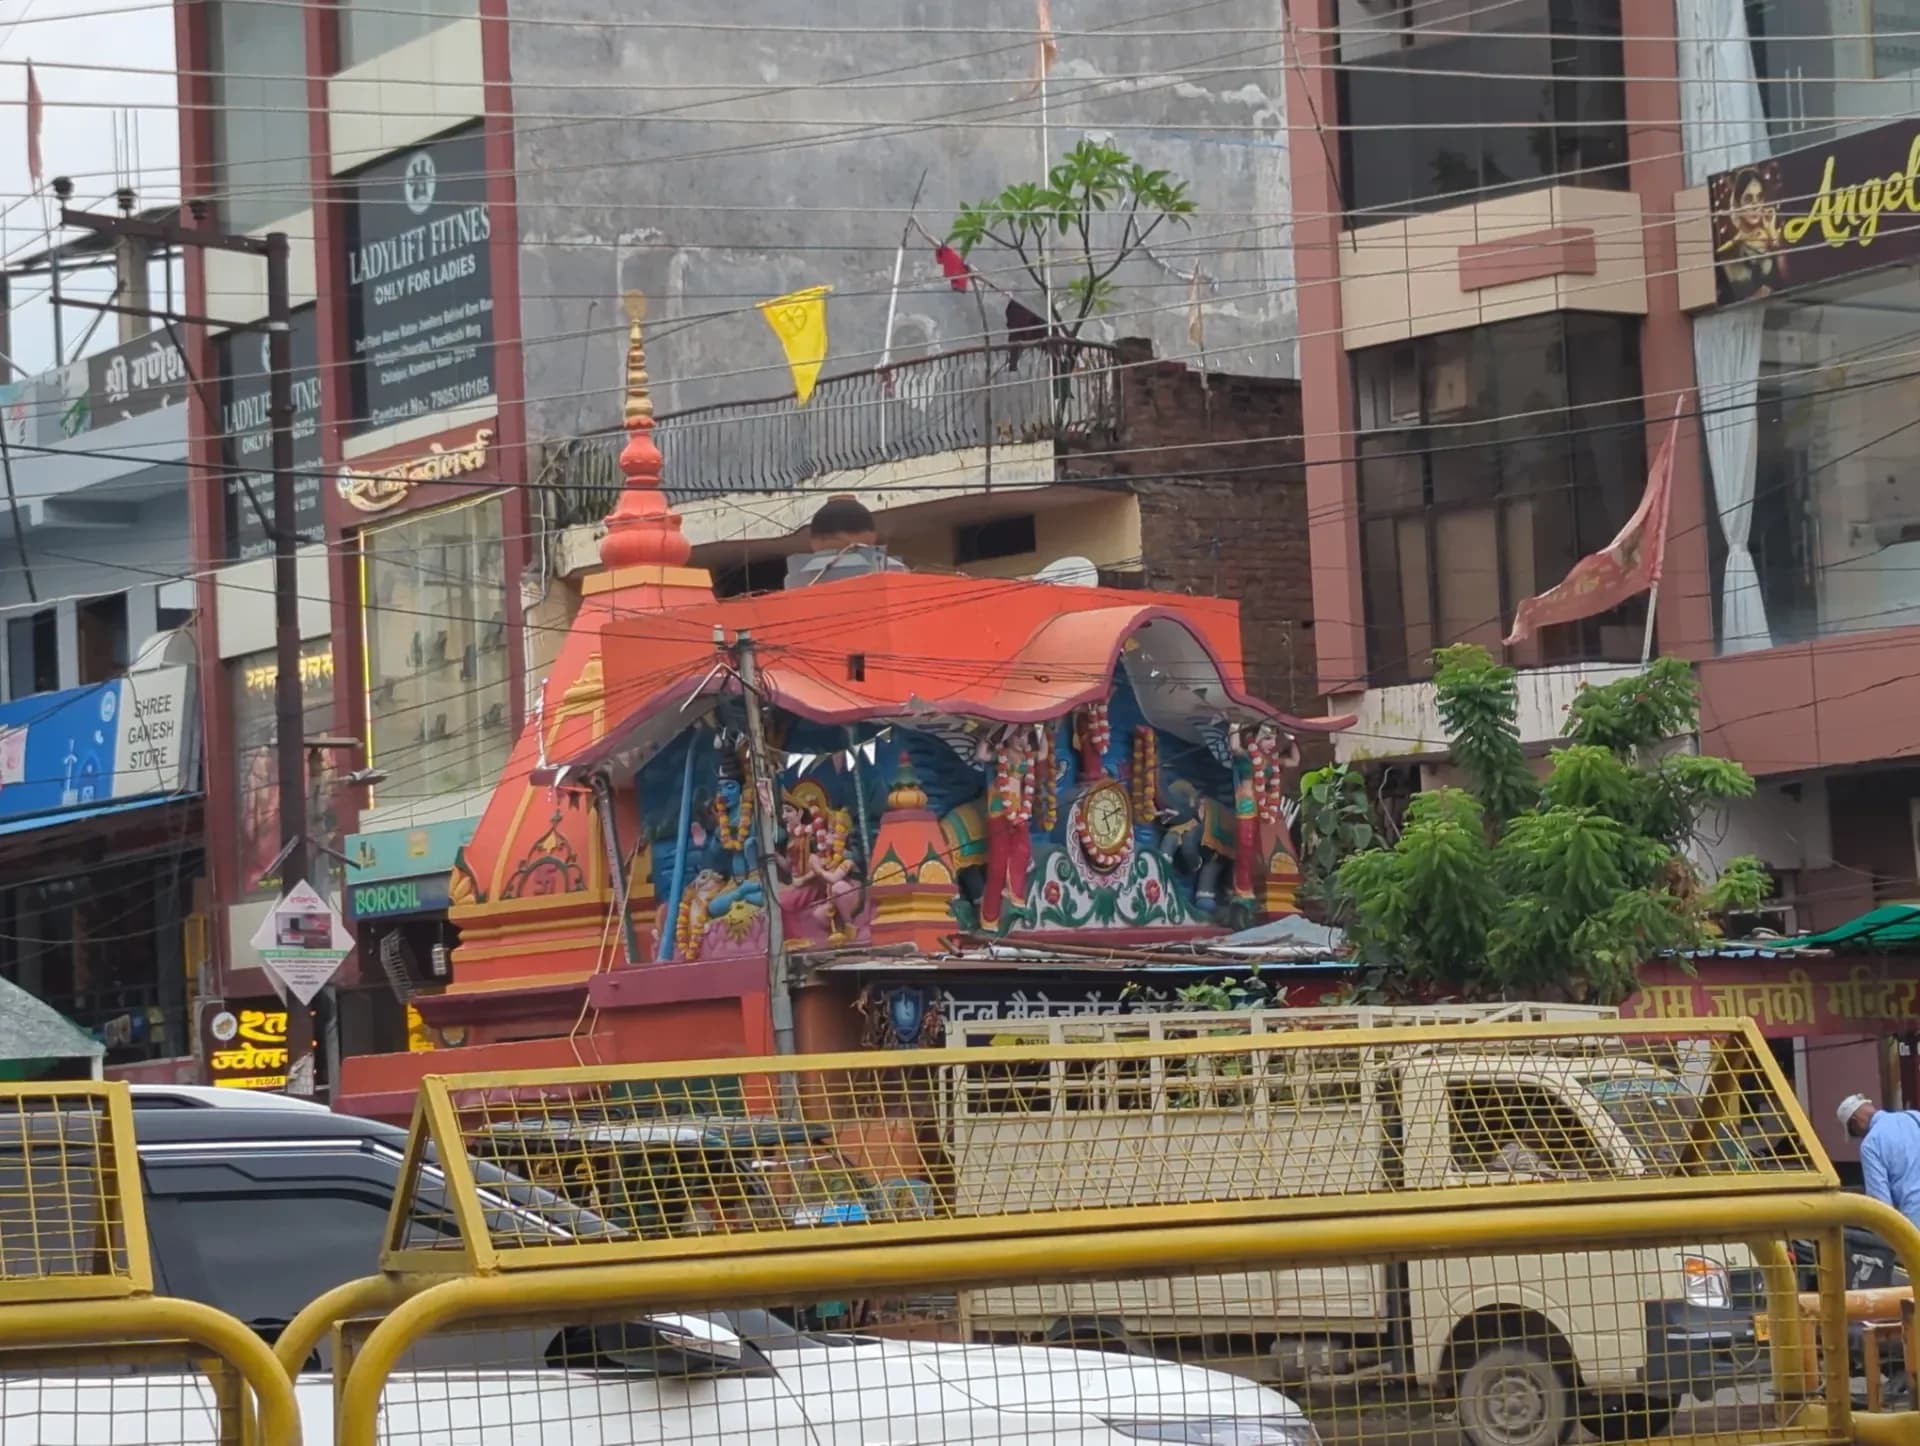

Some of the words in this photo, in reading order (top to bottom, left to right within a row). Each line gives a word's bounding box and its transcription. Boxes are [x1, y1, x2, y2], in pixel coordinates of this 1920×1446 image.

[1784, 133, 1920, 248] Angel
[350, 225, 426, 285] LADYLIFT
[375, 278, 406, 305] ONLY
[408, 269, 431, 295] FOR
[434, 253, 476, 286] LADIES
[105, 355, 130, 403] श्री
[134, 694, 172, 718] SHREE
[128, 721, 174, 744] GANESH
[130, 747, 168, 769] STORE
[355, 882, 422, 915] BOROSIL
[1634, 985, 1692, 1018] राम
[1703, 966, 1816, 1025] जानकी
